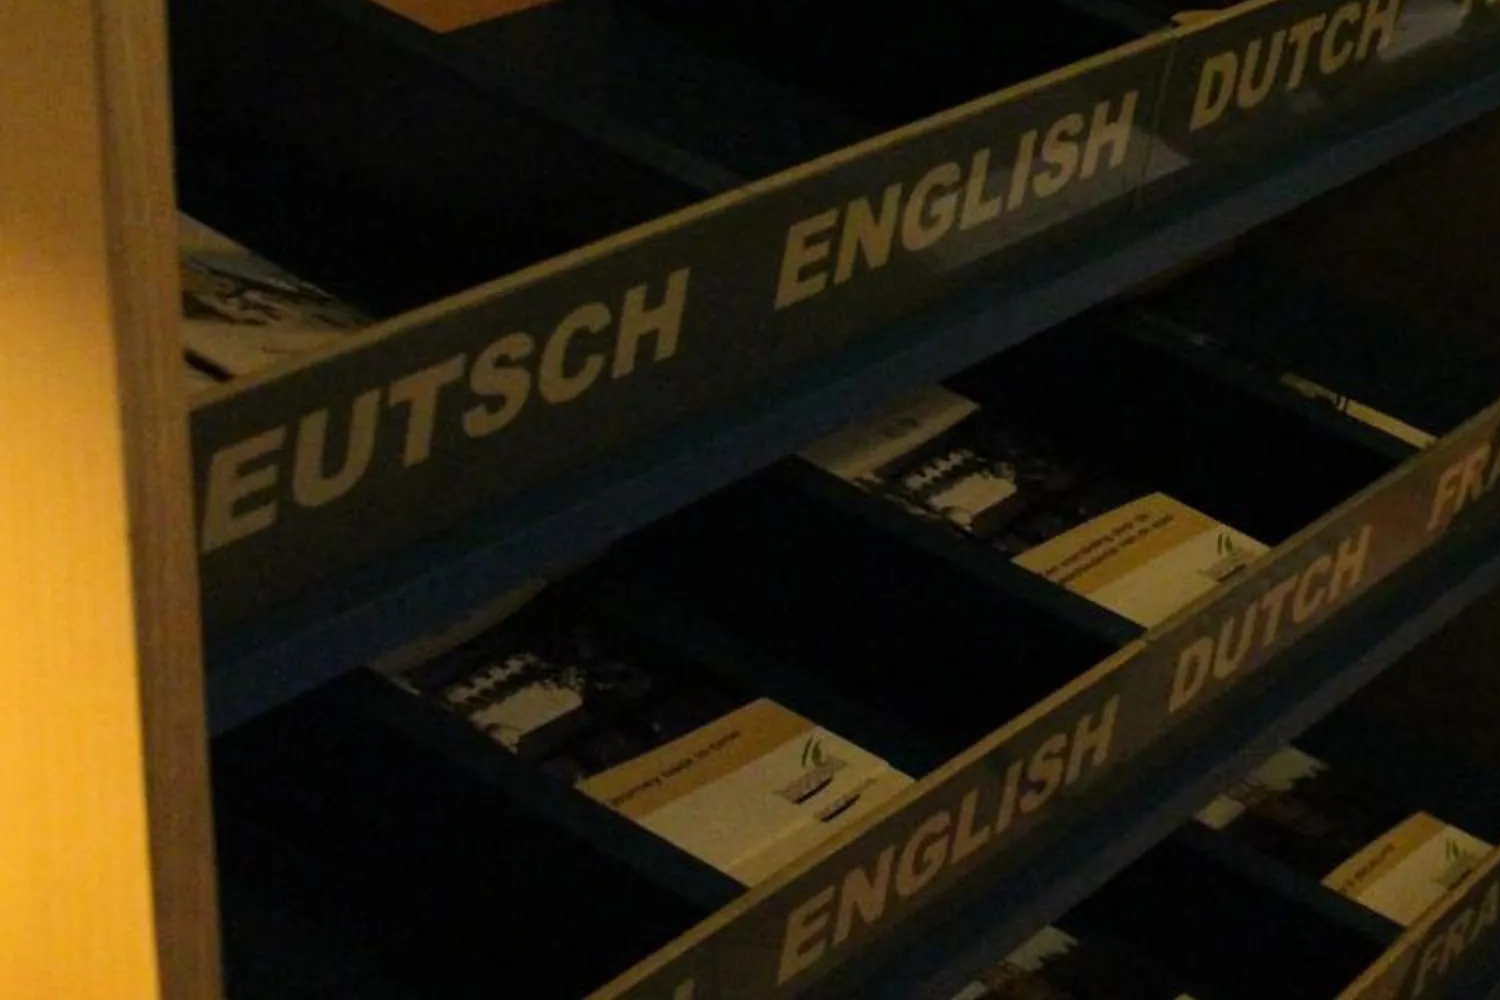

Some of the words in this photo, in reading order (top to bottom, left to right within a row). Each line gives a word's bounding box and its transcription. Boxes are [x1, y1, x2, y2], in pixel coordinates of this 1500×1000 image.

[201, 267, 692, 554] EUTSCH
[773, 90, 1139, 313] ENGLISH
[776, 694, 1121, 985] ENGLISH
[1168, 523, 1373, 713] DUTCH
